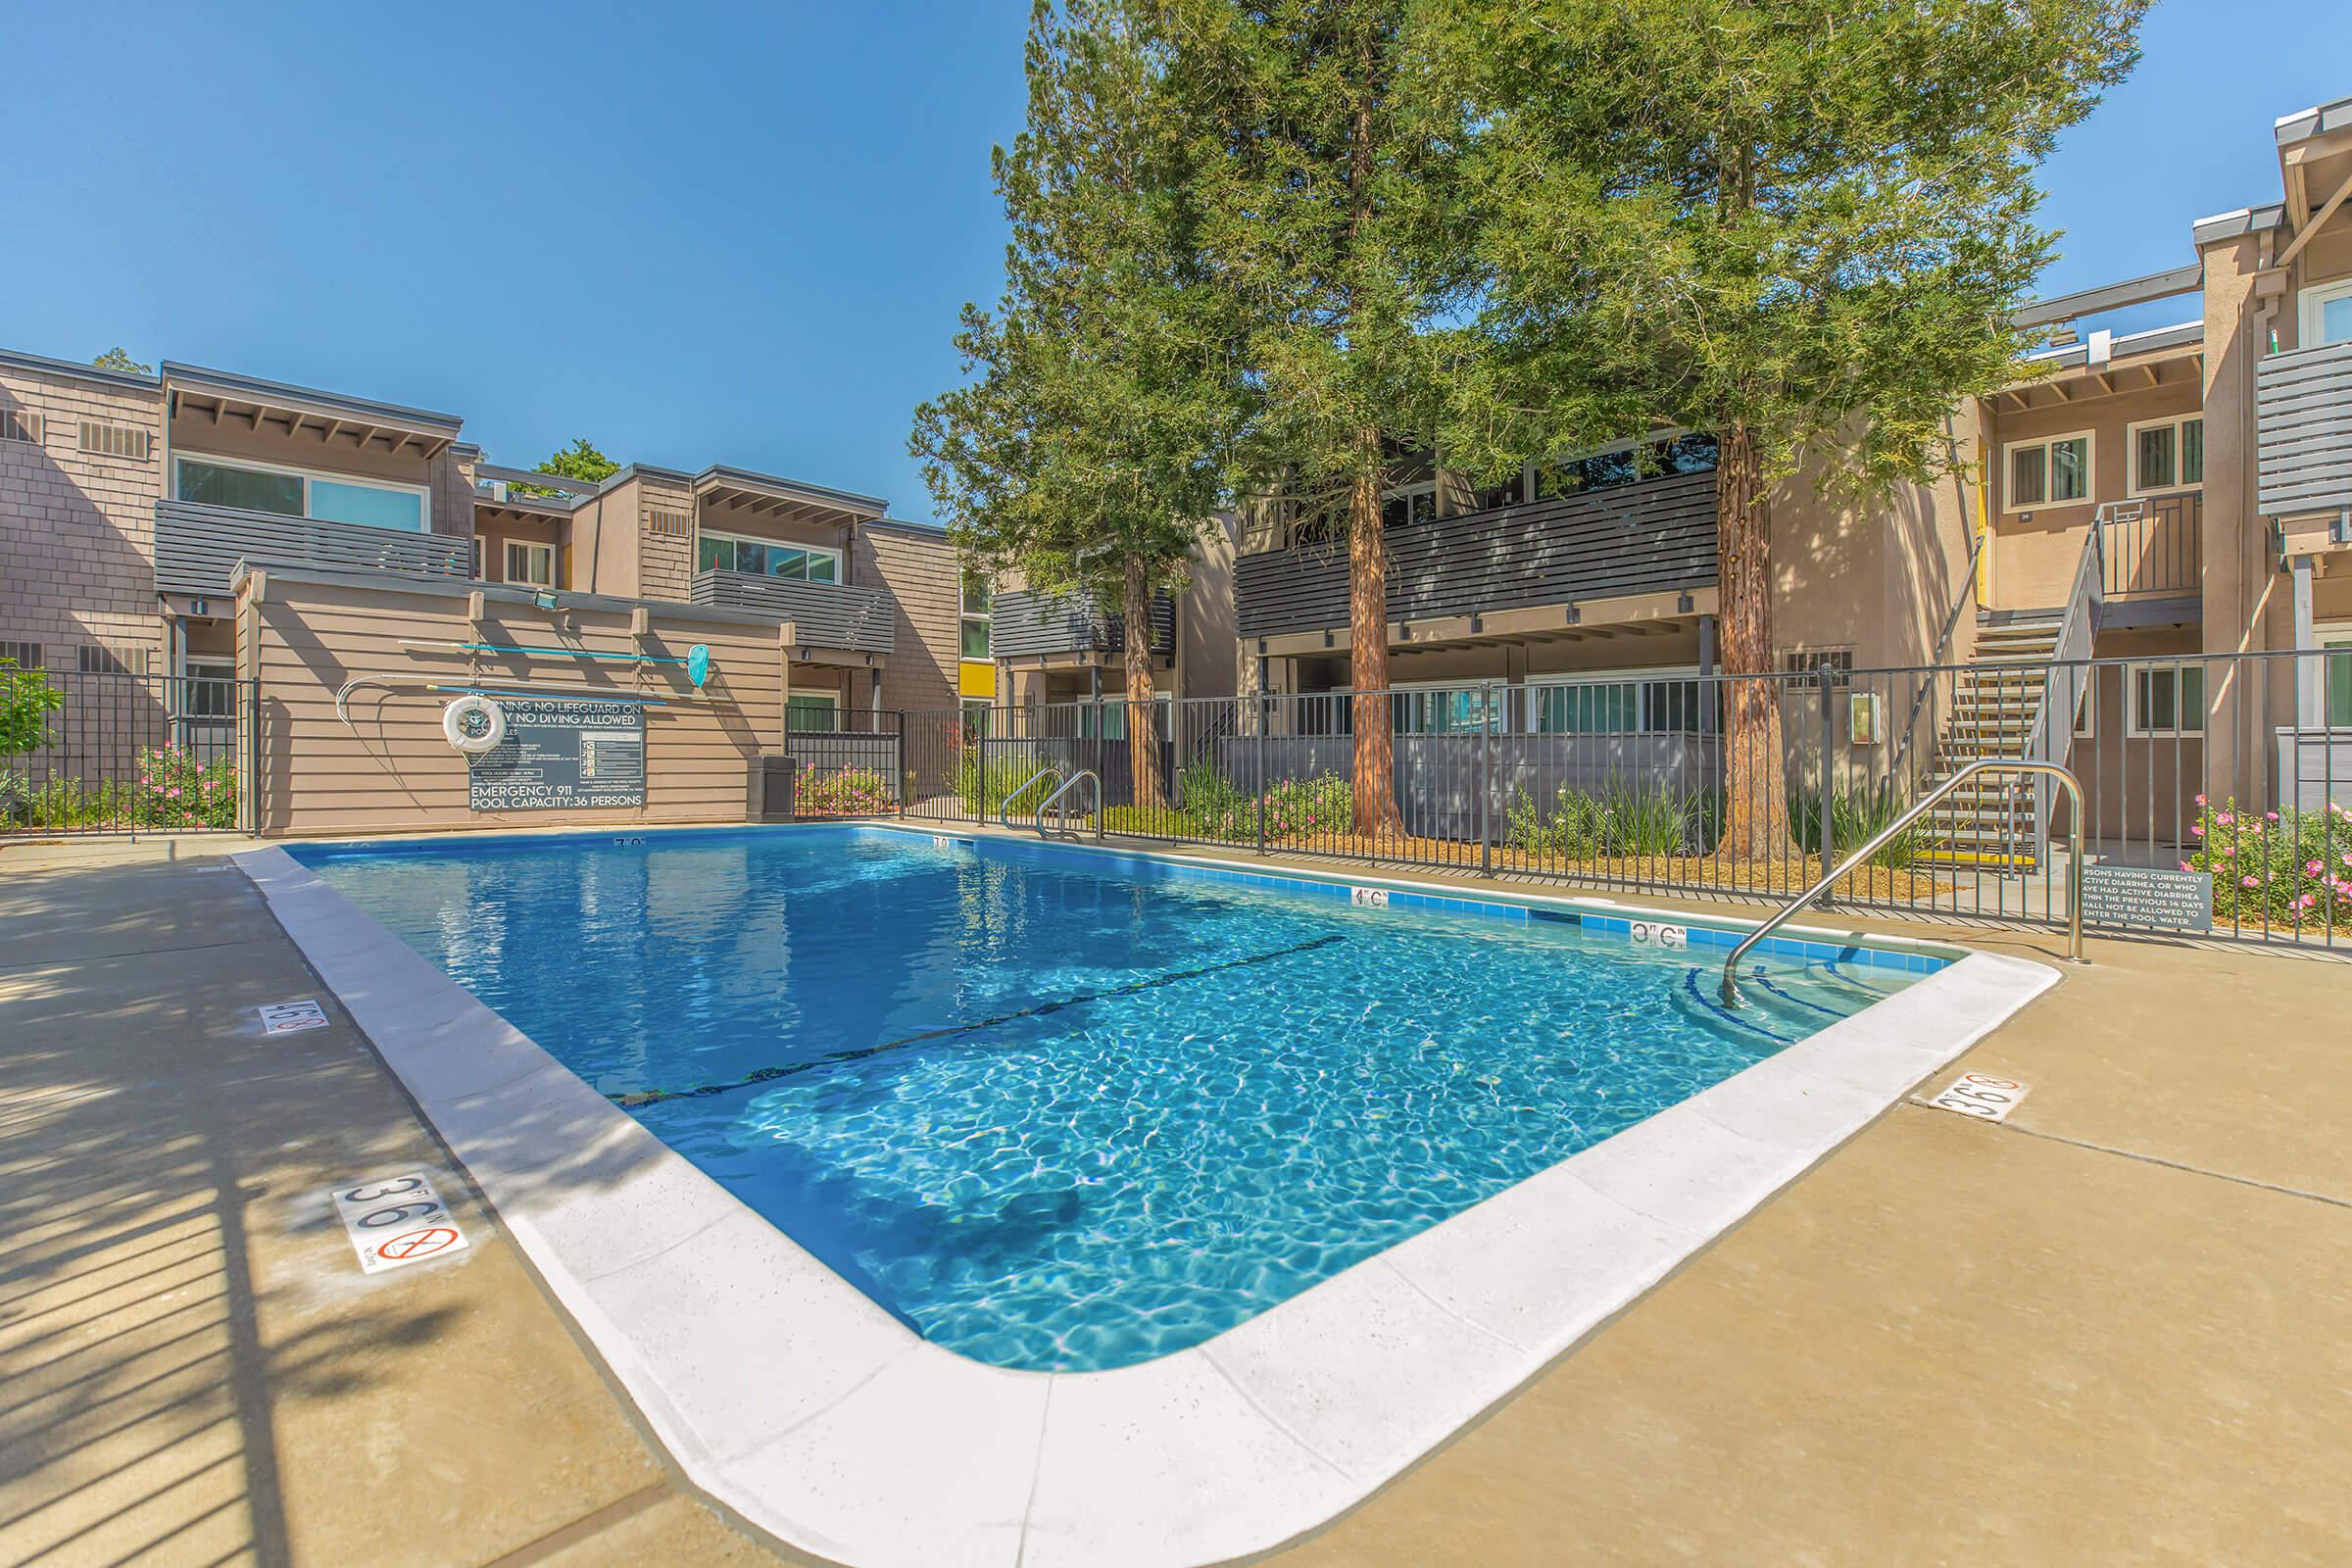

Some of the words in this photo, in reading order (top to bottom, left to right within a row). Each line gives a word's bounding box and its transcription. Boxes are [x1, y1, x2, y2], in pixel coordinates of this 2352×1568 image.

[497, 700, 531, 711] NING
[535, 701, 555, 712] NO
[558, 702, 619, 714] LIFEGUARD
[622, 705, 641, 714] ON
[516, 712, 536, 723] NO
[540, 713, 580, 724] DIVING
[583, 714, 636, 725] ALLOWED
[471, 785, 554, 797] EMERGENCY
[557, 785, 572, 796] 911
[471, 797, 509, 808] POOL
[591, 795, 642, 807] PERSONS
[2114, 870, 2148, 880] HAVING
[2150, 873, 2203, 883] CURRENTLY
[2111, 879, 2154, 889] DIARRHEA
[2174, 883, 2197, 892] WHO
[2121, 888, 2152, 897] ACTIVE
[2154, 891, 2199, 901] DIARRHEA
[2082, 901, 2104, 909] HALL
[2106, 903, 2125, 911] NOT
[2139, 906, 2183, 916] ALLOWED
[2122, 897, 2167, 906] PREVIOUS
[2181, 901, 2204, 909] DAYS
[2083, 909, 2110, 918] ENTER
[2112, 911, 2129, 920] THE
[2131, 913, 2157, 922] POOL
[2159, 915, 2192, 926] WATER.
[1953, 1087, 2012, 1102] 6
[1937, 1099, 1998, 1114] 3
[344, 1177, 422, 1202] 3
[357, 1201, 439, 1228] 6
